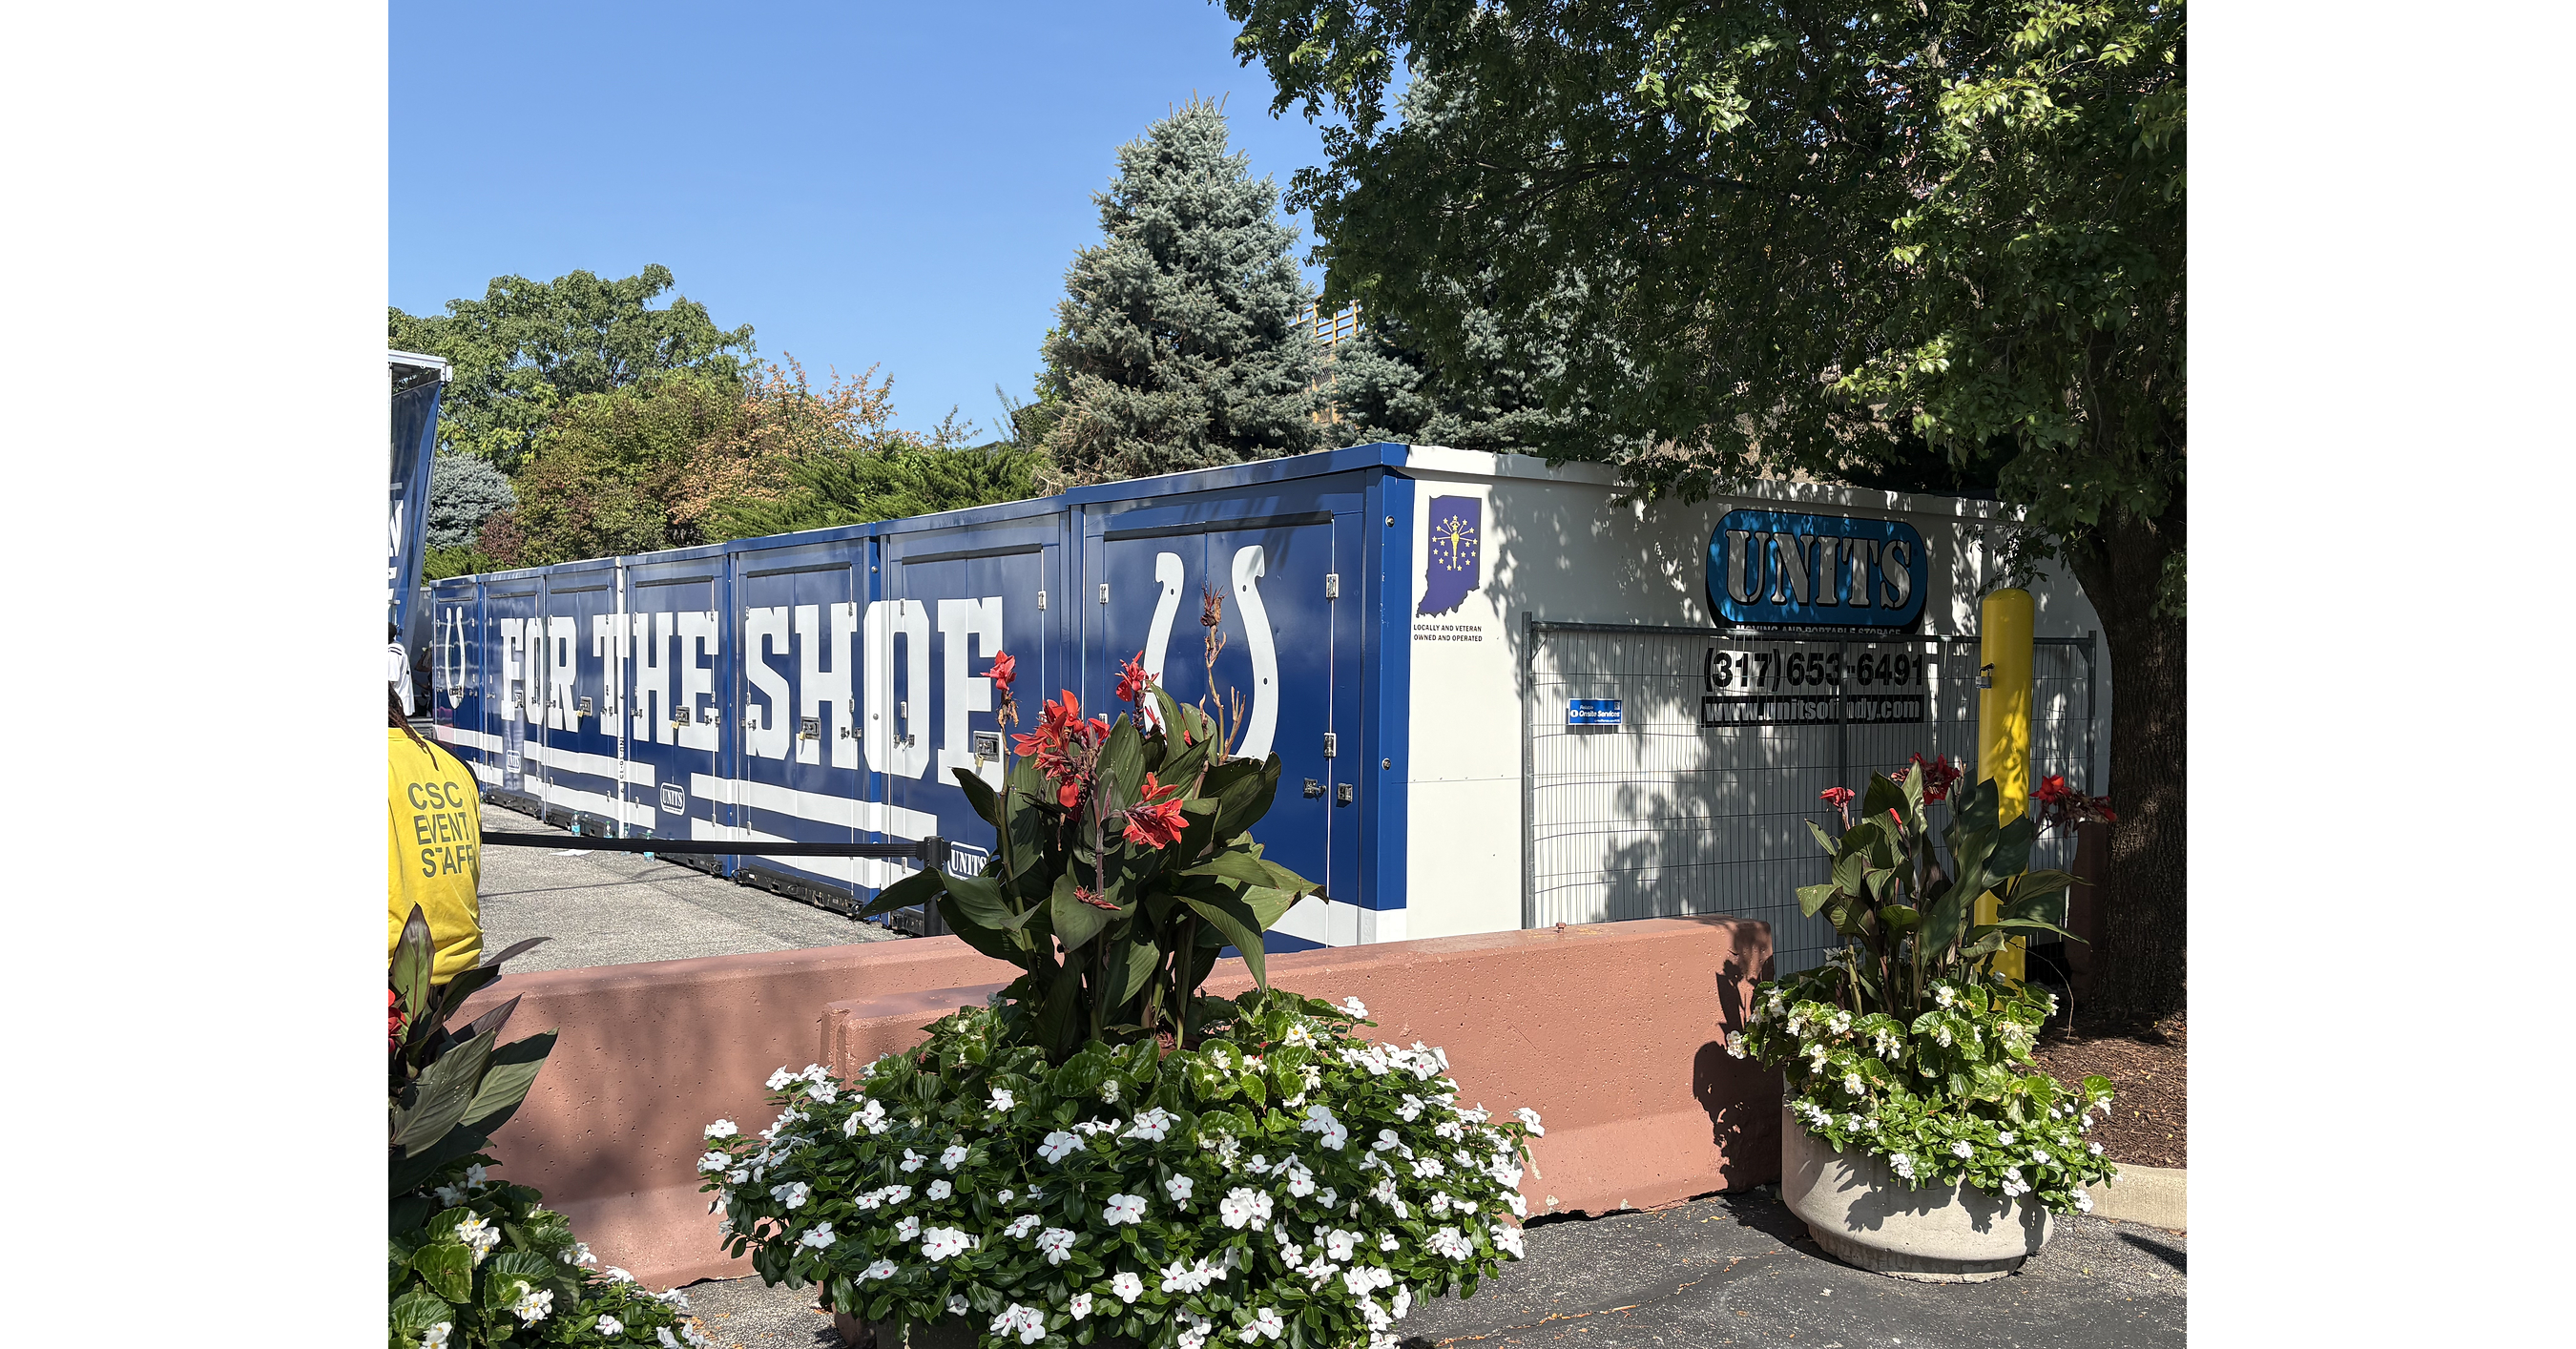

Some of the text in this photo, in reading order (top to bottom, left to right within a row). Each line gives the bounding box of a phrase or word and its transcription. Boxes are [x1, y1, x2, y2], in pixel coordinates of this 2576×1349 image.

[1725, 529, 1912, 611] UNITS
[499, 596, 1005, 793] FOR THE SHOE
[1705, 697, 1921, 722] www.unitsofindy.com
[407, 781, 463, 810] CSC
[662, 788, 683, 808] UNITS
[413, 812, 469, 845] EVENT
[421, 844, 473, 878] STAFF
[950, 849, 987, 877] UNITS
